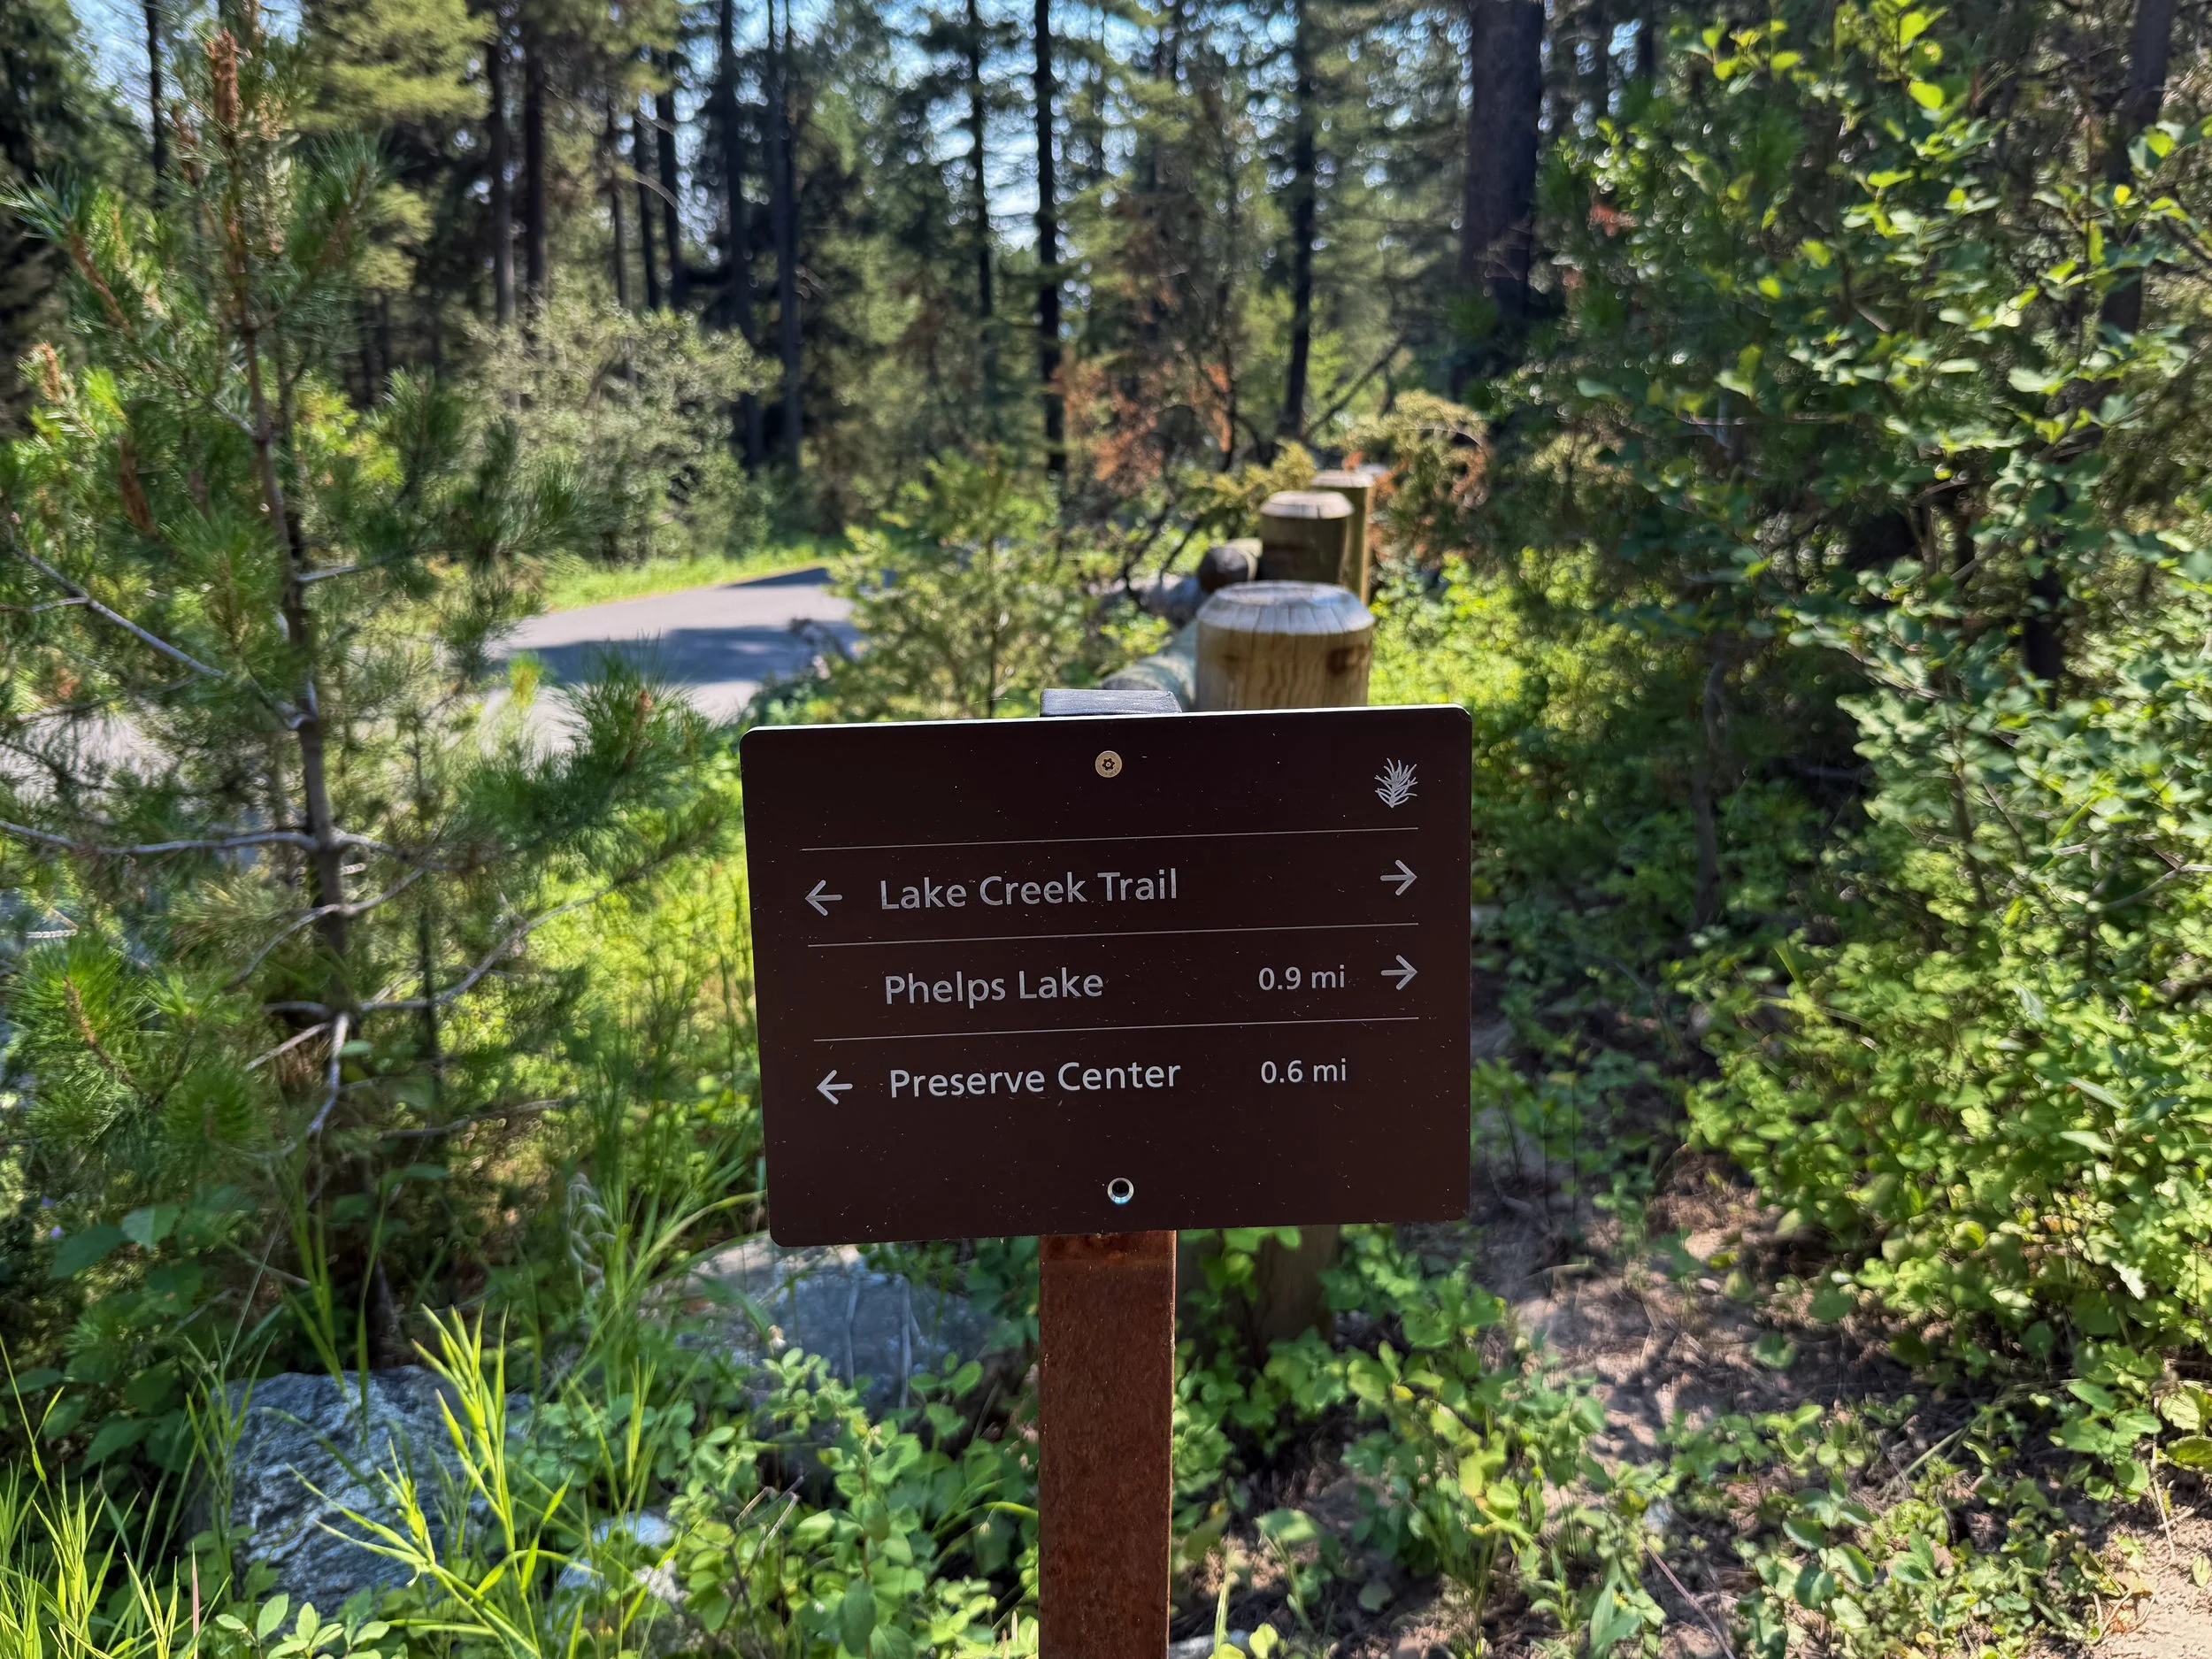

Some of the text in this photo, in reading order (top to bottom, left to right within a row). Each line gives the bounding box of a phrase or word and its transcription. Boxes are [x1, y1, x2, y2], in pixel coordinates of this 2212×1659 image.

[880, 867, 1177, 910] Lake Creek Trail
[885, 966, 1103, 1010] Phelps Lake
[1258, 964, 1345, 991] 0.9 mi
[890, 1062, 1181, 1098] Preserve Center
[1261, 1057, 1346, 1084] 0.6 mi
